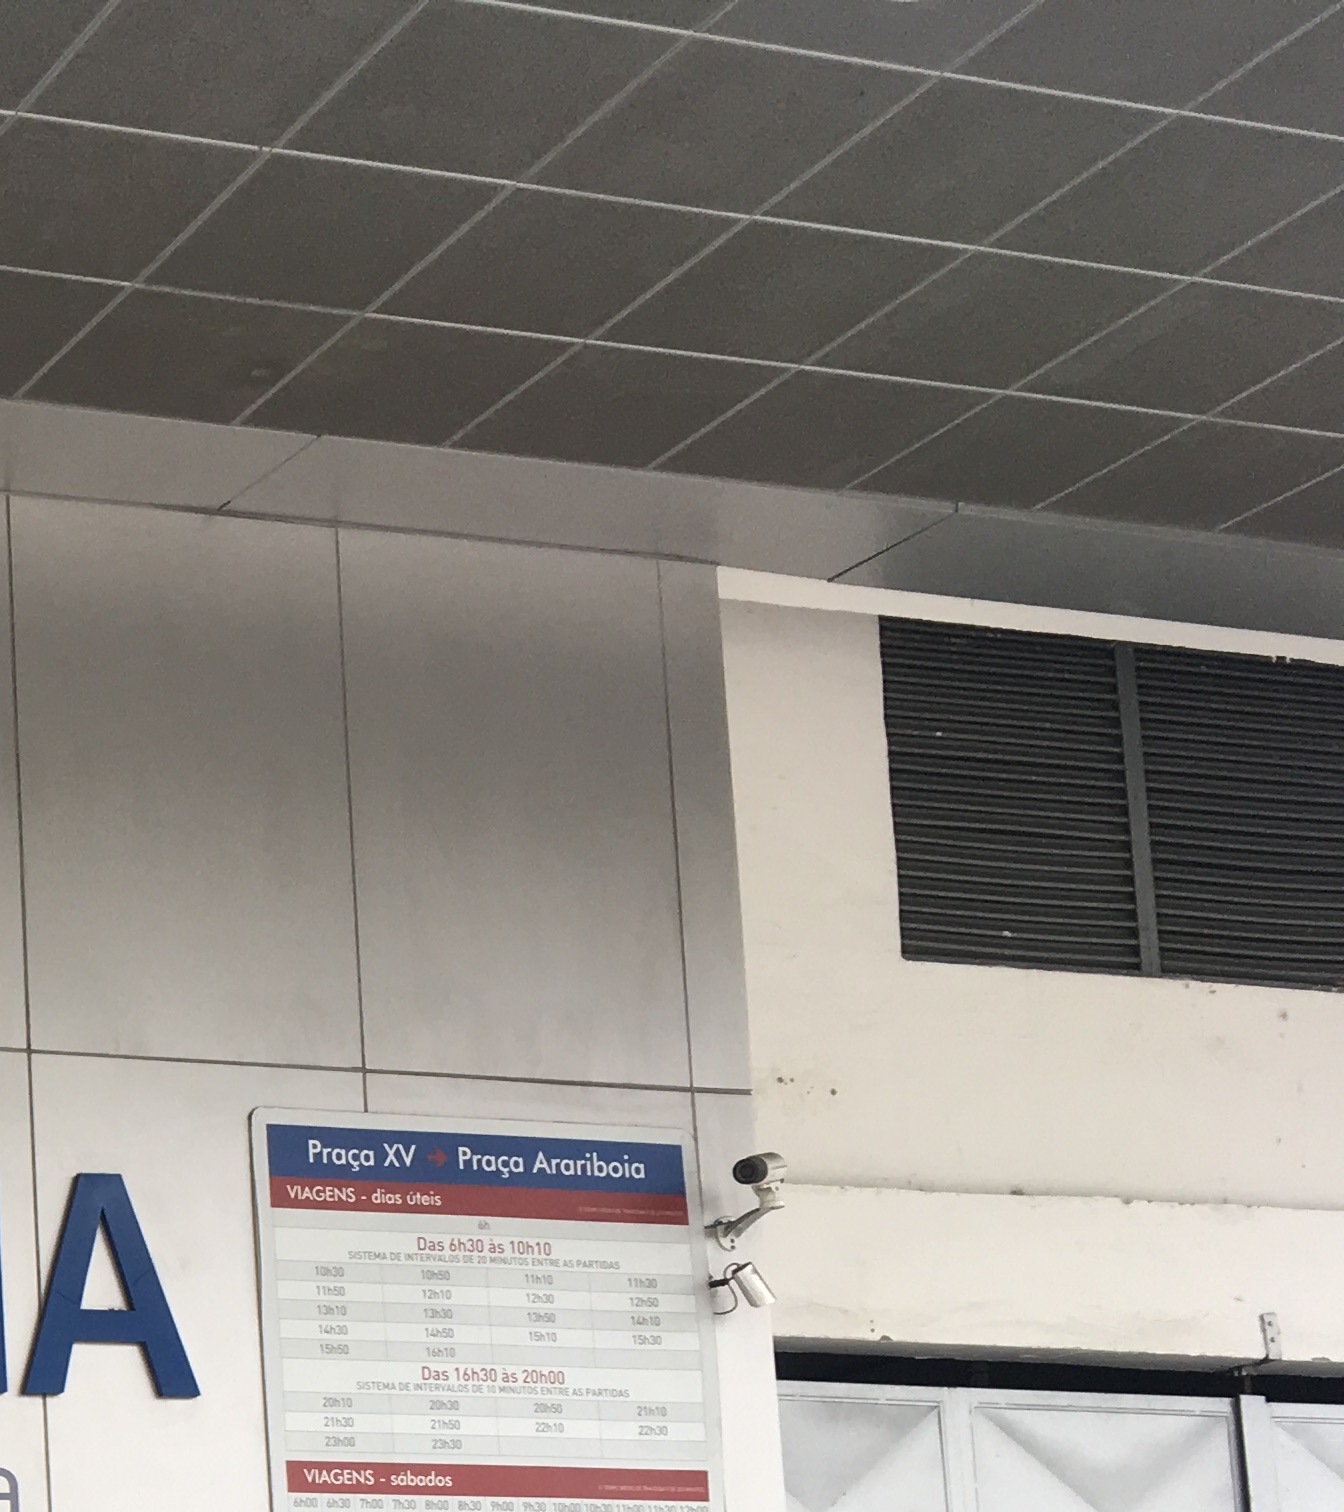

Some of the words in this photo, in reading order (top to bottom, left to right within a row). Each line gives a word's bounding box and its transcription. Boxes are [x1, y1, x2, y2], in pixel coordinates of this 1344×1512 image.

[308, 1139, 375, 1172] Praça
[382, 1142, 417, 1168] XV
[457, 1146, 525, 1179] Praça
[532, 1150, 646, 1179] Arariboia
[286, 1184, 356, 1203] VIAGENS
[371, 1188, 403, 1205] dias
[406, 1190, 442, 1207] úteis
[416, 1236, 445, 1253] Das
[448, 1237, 484, 1254] 6h30
[487, 1242, 506, 1255] às
[509, 1240, 552, 1257] 10h10
[421, 1365, 450, 1382] Das
[454, 1366, 498, 1383] 16h30
[501, 1367, 519, 1384] às
[521, 1369, 565, 1386] 20h00
[303, 1468, 375, 1486] VIAGENS
[390, 1469, 453, 1487] sábados
